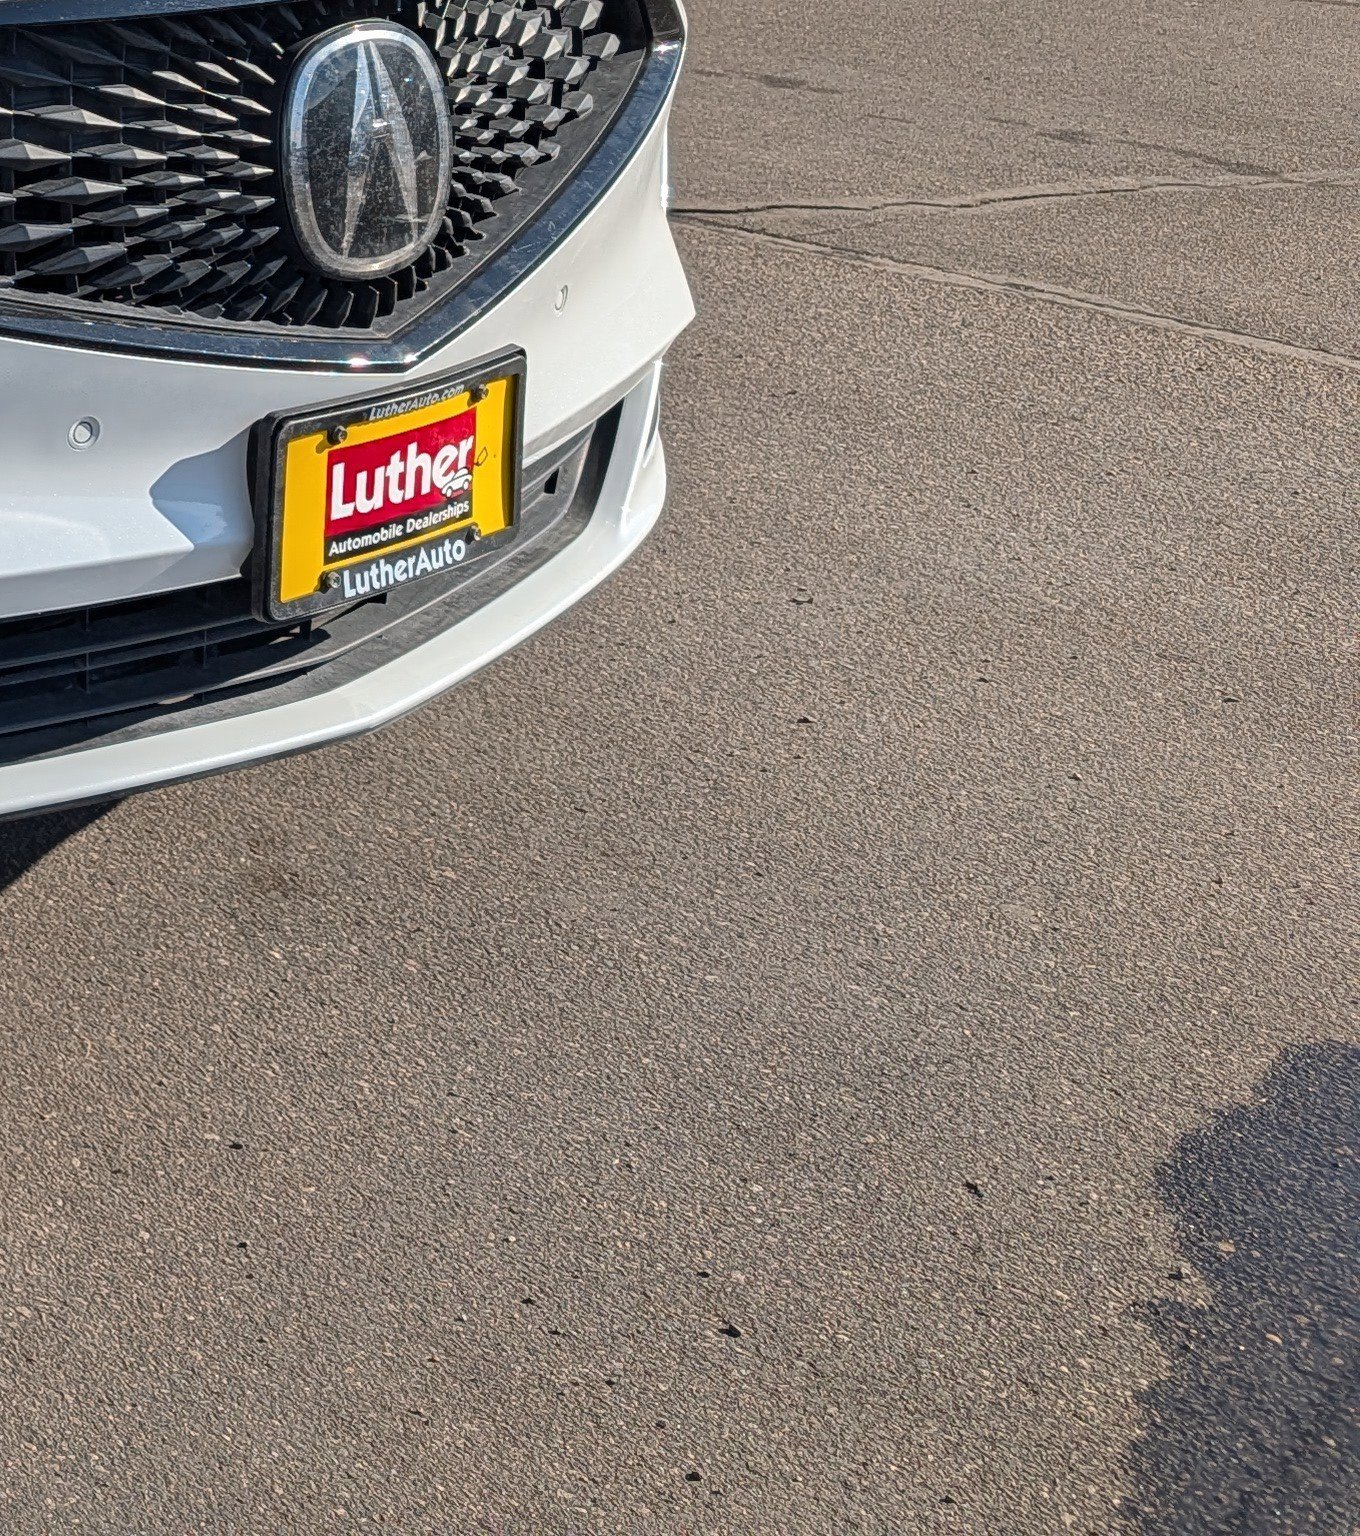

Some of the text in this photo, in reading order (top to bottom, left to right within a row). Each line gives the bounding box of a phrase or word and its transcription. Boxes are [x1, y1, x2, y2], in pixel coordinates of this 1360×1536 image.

[368, 384, 465, 421] LutherAuto.com
[330, 434, 475, 521] Luther
[329, 500, 471, 557] Automobile Dealerships
[343, 537, 466, 599] LutherAuto
